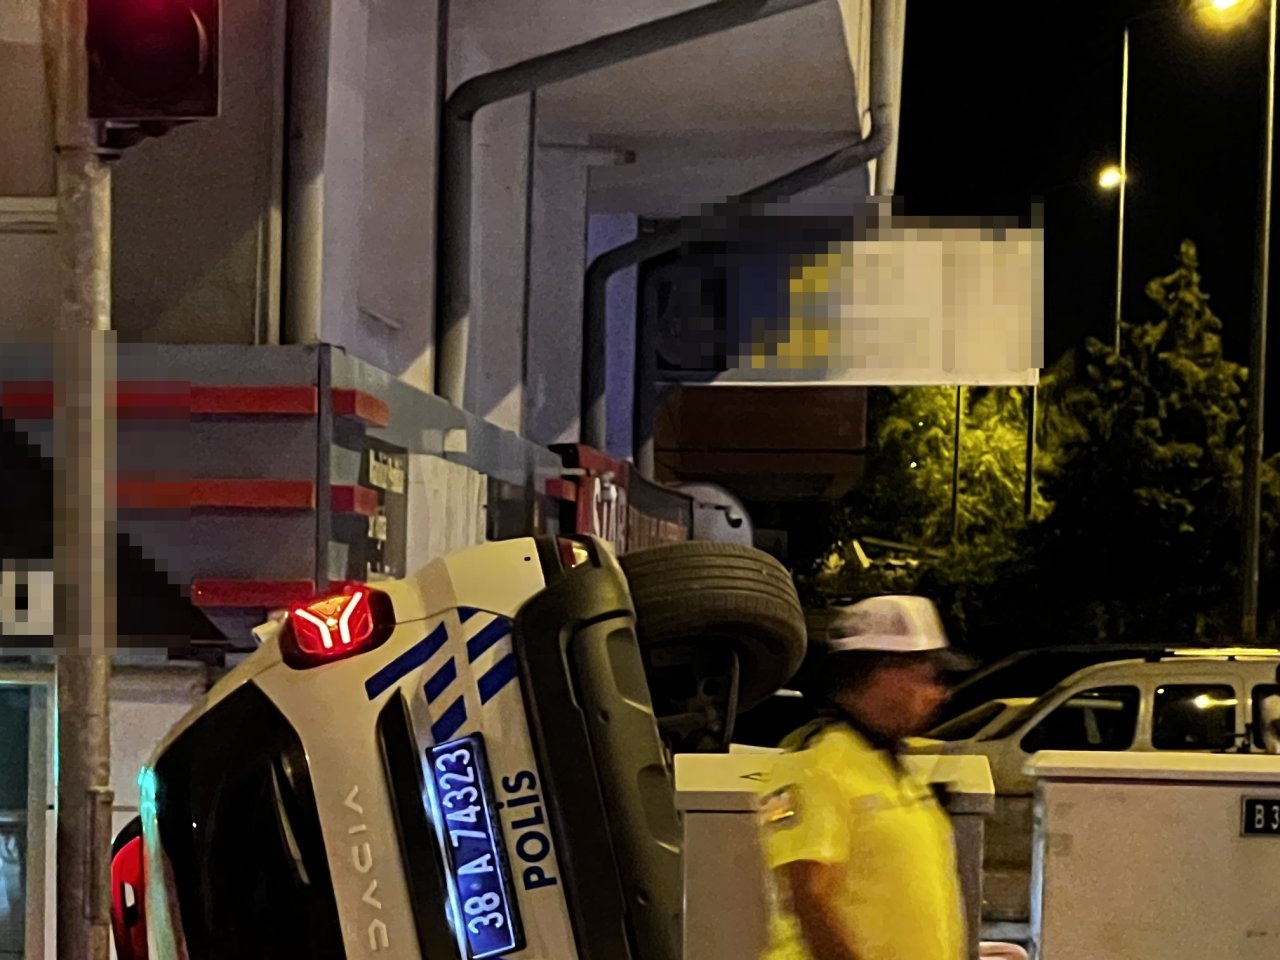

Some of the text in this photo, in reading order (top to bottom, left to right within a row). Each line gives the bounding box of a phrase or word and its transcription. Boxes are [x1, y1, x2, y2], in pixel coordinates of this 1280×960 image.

[344, 785, 389, 951] DACIA
[435, 748, 504, 934] 38 A 74323
[495, 770, 558, 890] POLİS
